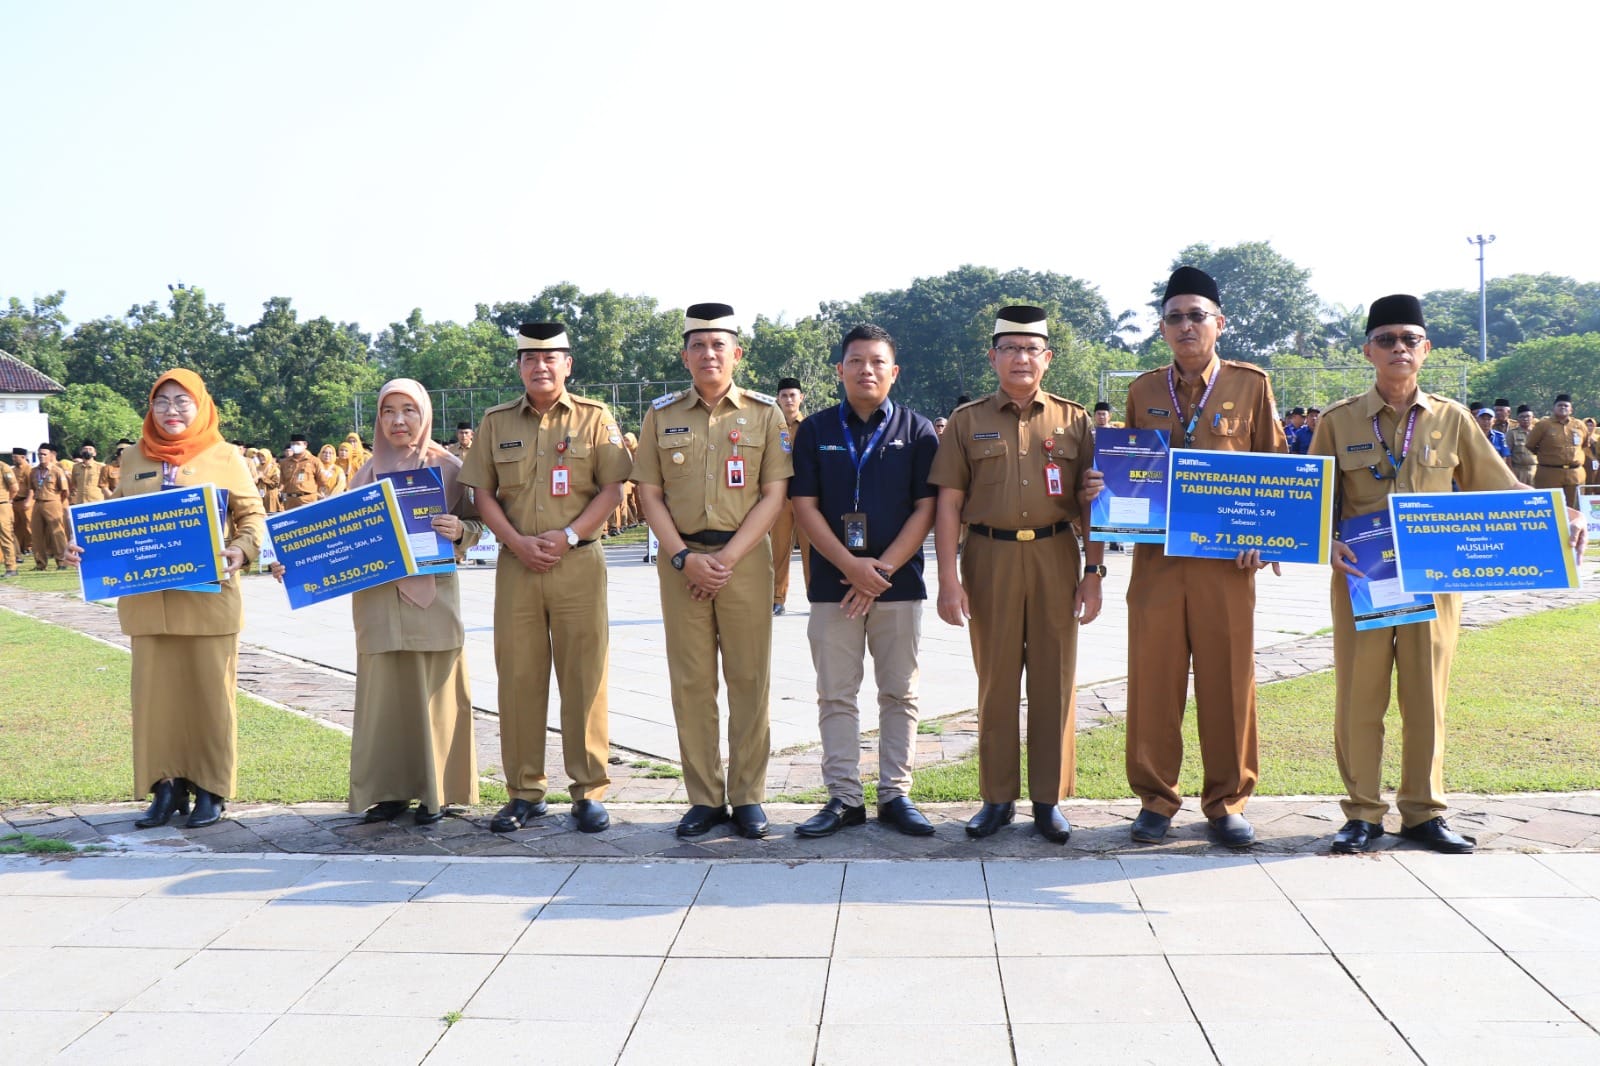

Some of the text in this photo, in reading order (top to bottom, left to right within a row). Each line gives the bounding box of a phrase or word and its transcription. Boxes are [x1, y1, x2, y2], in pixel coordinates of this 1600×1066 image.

[1296, 465, 1319, 473] taspen
[1175, 471, 1257, 484] PENYERAHAN
[1260, 475, 1320, 487] MANFAAT
[1181, 484, 1313, 500] TABUNGAN HARI TUA
[77, 505, 205, 533] PENYERAHAN MANFAAT
[1260, 509, 1276, 517] S.Pd
[1398, 509, 1552, 522] PENYERAHAN MANFAAT
[274, 501, 385, 544] PENYERAHAN MANFAAT
[1406, 521, 1548, 534] TABUNGAN HARI TUA
[84, 518, 202, 544] TABUNGAN HARI TUA
[281, 514, 385, 553] TABUNGAN HARI TUA
[1190, 532, 1211, 545] Rp.
[1456, 543, 1504, 552] MUSLIHAT
[1425, 568, 1448, 581] Rp.
[102, 576, 122, 587] Rp.
[303, 583, 321, 593] Rp.
